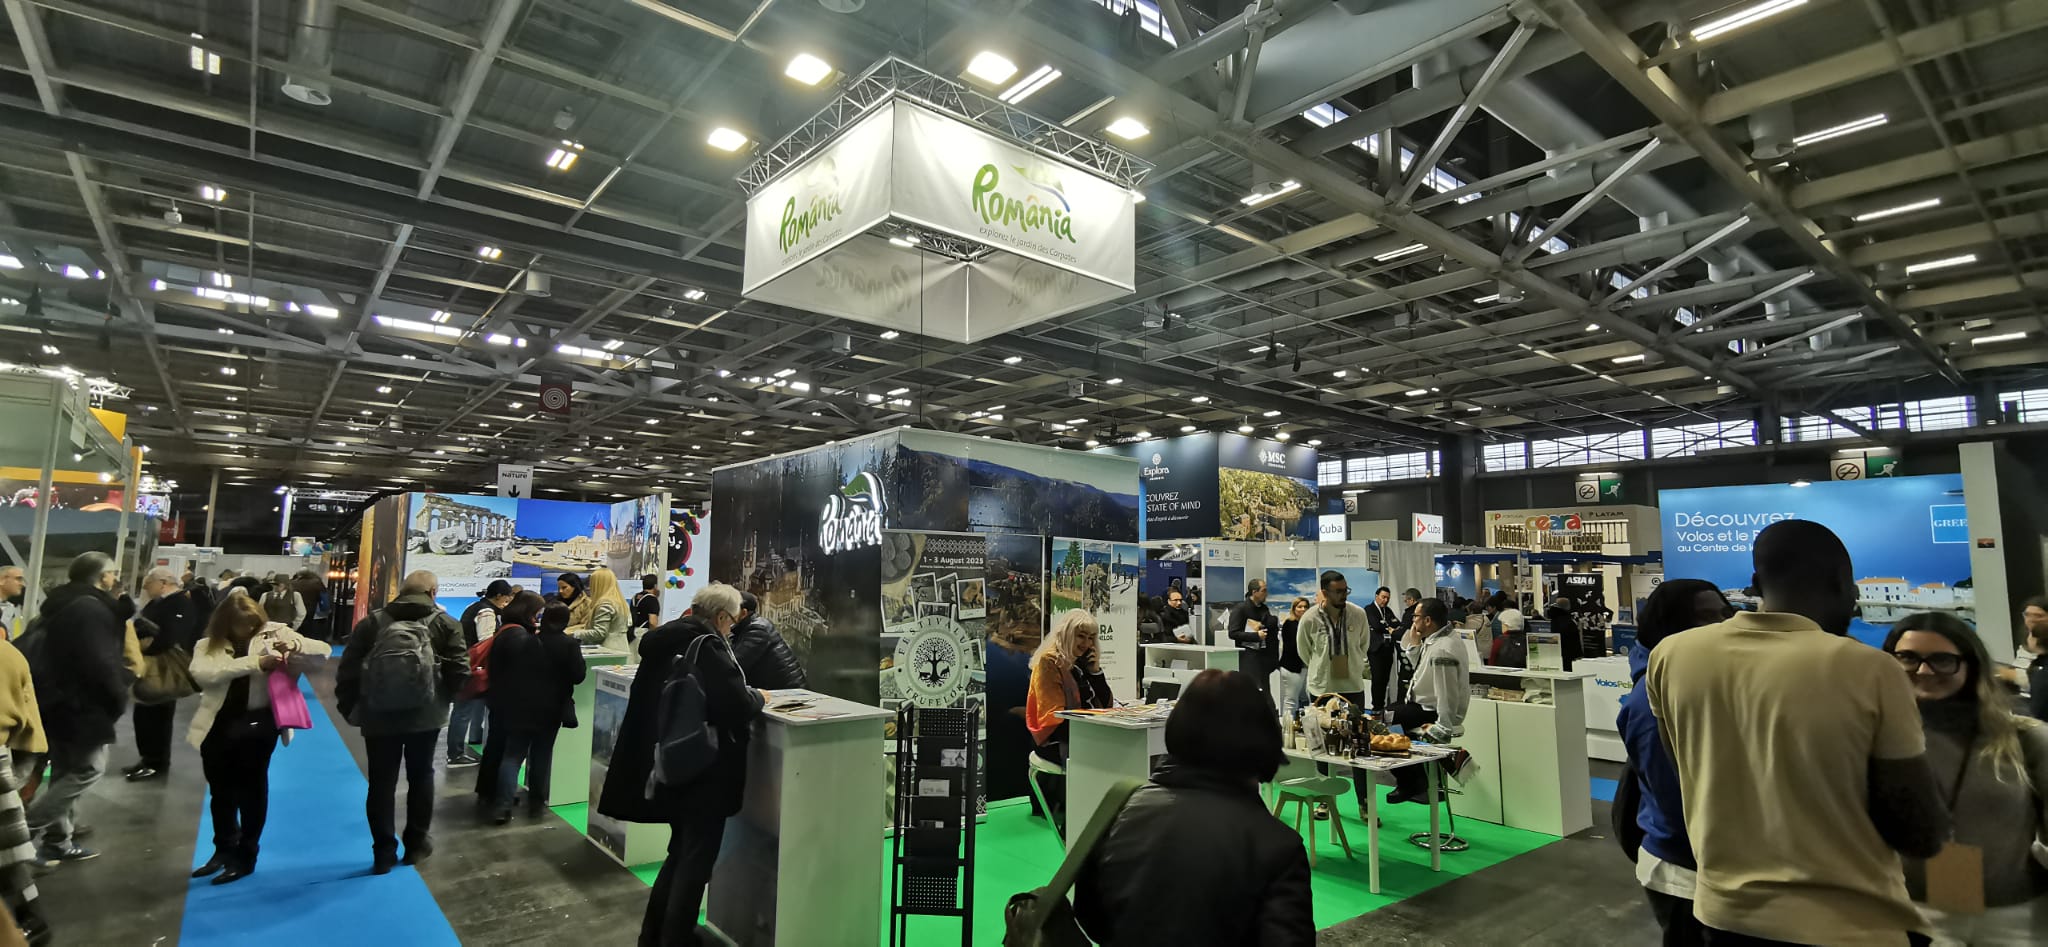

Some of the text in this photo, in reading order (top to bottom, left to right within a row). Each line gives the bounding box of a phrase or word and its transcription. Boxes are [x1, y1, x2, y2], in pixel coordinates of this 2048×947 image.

[1267, 451, 1286, 464] MSC
[1143, 466, 1170, 477] Explora
[1147, 501, 1200, 512] STATE OF MIND
[1320, 524, 1343, 533] Cuba
[1427, 524, 1441, 534] Cuba
[1677, 531, 1714, 542] Volos
[1717, 530, 1733, 541] et
[1736, 530, 1748, 541] le
[1677, 544, 1691, 552] au
[1693, 544, 1729, 552] Centre
[1731, 544, 1747, 552] de
[940, 556, 964, 565] August
[898, 617, 970, 656] FESTIVALUL
